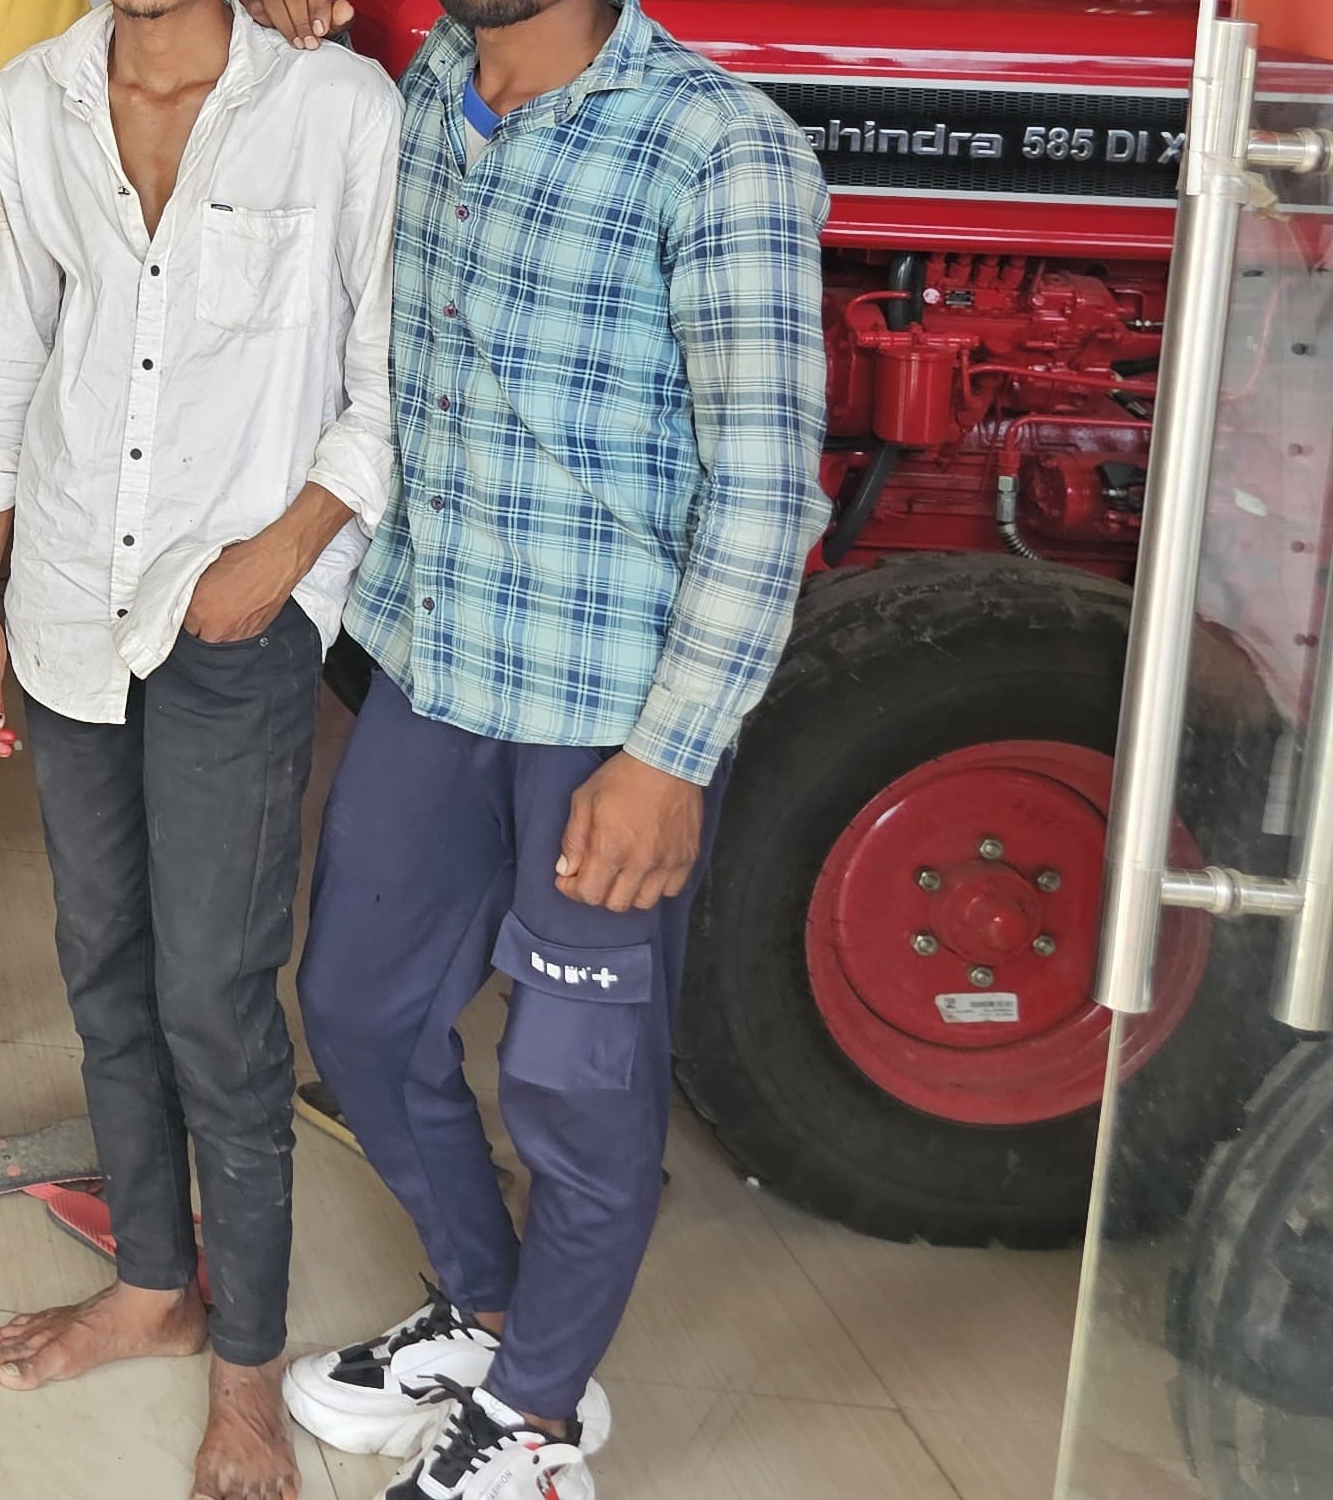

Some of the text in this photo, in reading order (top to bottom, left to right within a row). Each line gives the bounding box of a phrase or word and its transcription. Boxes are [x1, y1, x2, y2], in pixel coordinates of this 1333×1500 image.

[804, 119, 1005, 159] ahindra
[1022, 126, 1094, 161] 585
[1107, 129, 1149, 163] DI
